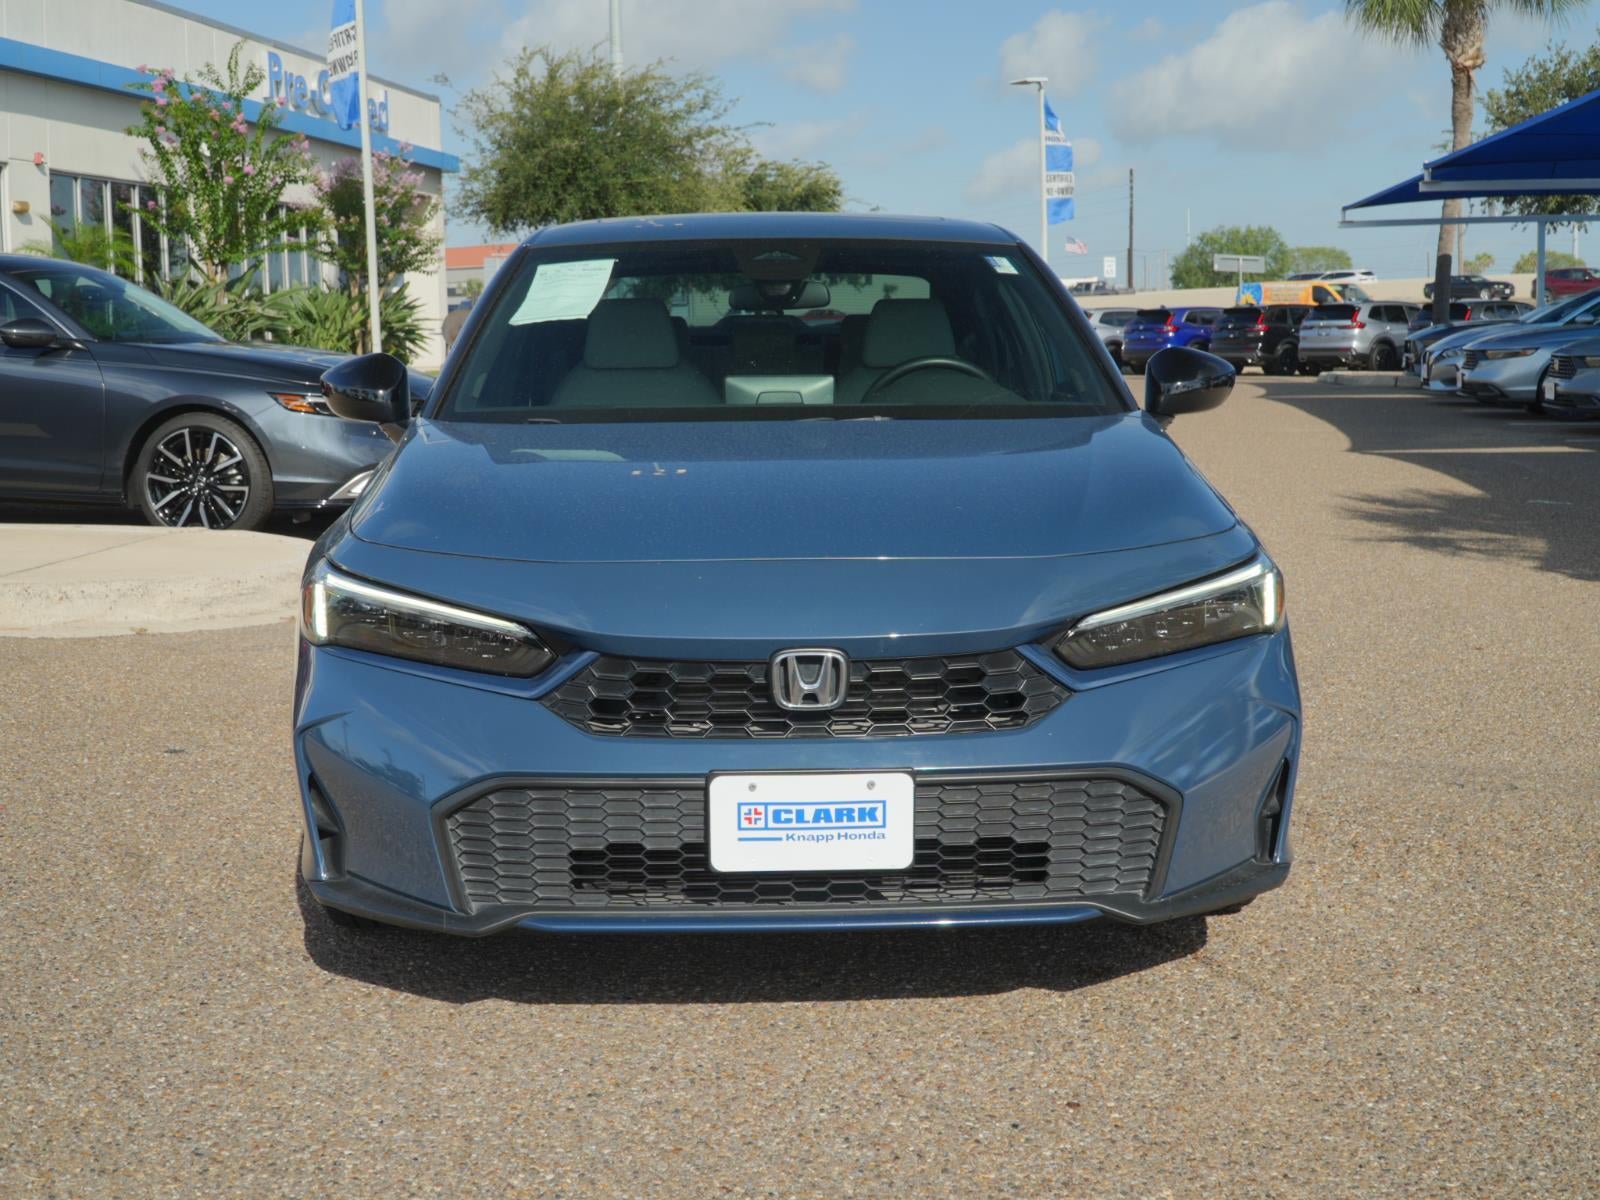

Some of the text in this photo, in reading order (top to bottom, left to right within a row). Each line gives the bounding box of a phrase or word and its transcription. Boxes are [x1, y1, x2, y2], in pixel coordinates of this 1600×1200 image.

[772, 806, 879, 825] CLARK
[785, 831, 886, 843] Knapp Honda
